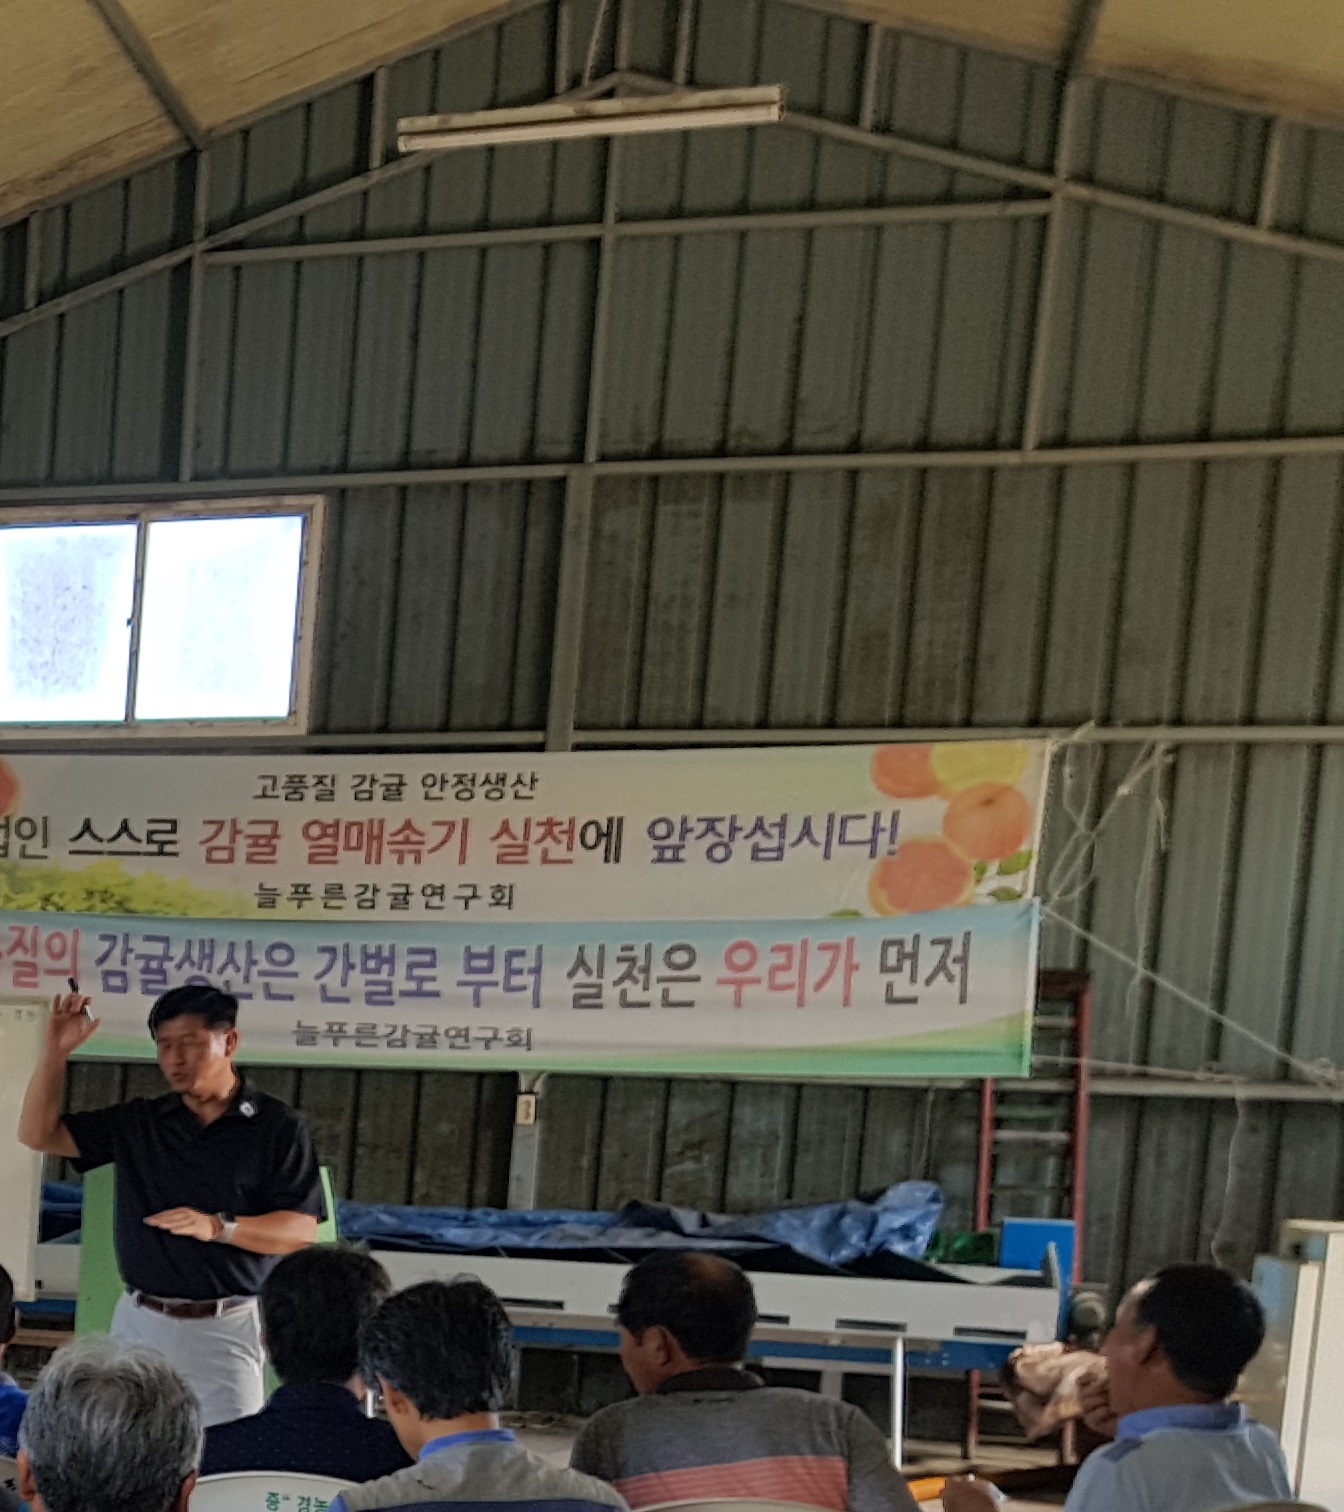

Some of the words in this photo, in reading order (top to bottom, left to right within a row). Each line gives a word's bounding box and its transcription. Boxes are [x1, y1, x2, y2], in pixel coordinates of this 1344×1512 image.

[253, 773, 337, 801] 고품질
[350, 772, 408, 802] 감귤
[420, 770, 541, 801] 안정생산
[68, 817, 181, 858] 스스로
[198, 818, 281, 866] 감귤
[302, 817, 470, 866] 열매솎기
[489, 814, 625, 866] 실천에
[646, 808, 902, 866] 앞장섭시다!
[253, 881, 516, 911] 늘푸른감귤연구회
[94, 932, 301, 1001] 감귤생산은
[313, 942, 441, 1006] 간벌로
[455, 943, 546, 1009] 부터
[566, 940, 702, 1010] 실천은
[716, 935, 861, 1009] 우리가
[879, 930, 973, 1006] 먼저
[292, 1019, 534, 1052] 늘푸른감귤연구회
